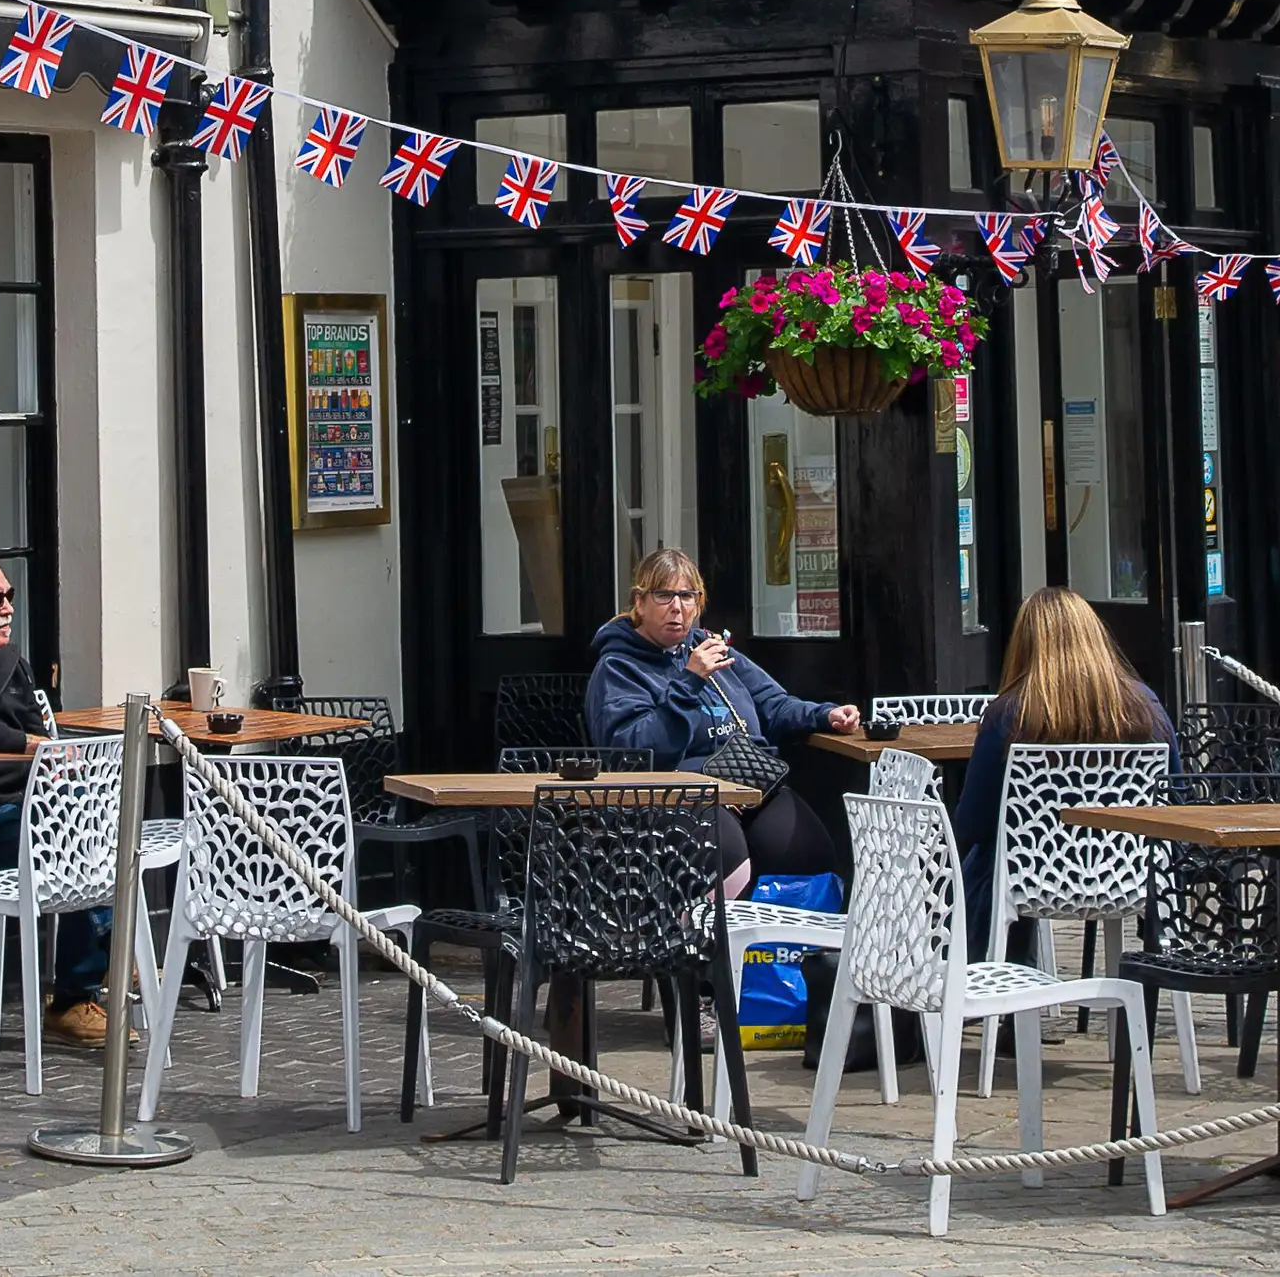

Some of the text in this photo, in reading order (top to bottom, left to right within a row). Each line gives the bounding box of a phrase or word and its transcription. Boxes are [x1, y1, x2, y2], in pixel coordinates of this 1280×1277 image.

[307, 325, 368, 341] TOP BRANDS
[797, 554, 817, 571] DELI
